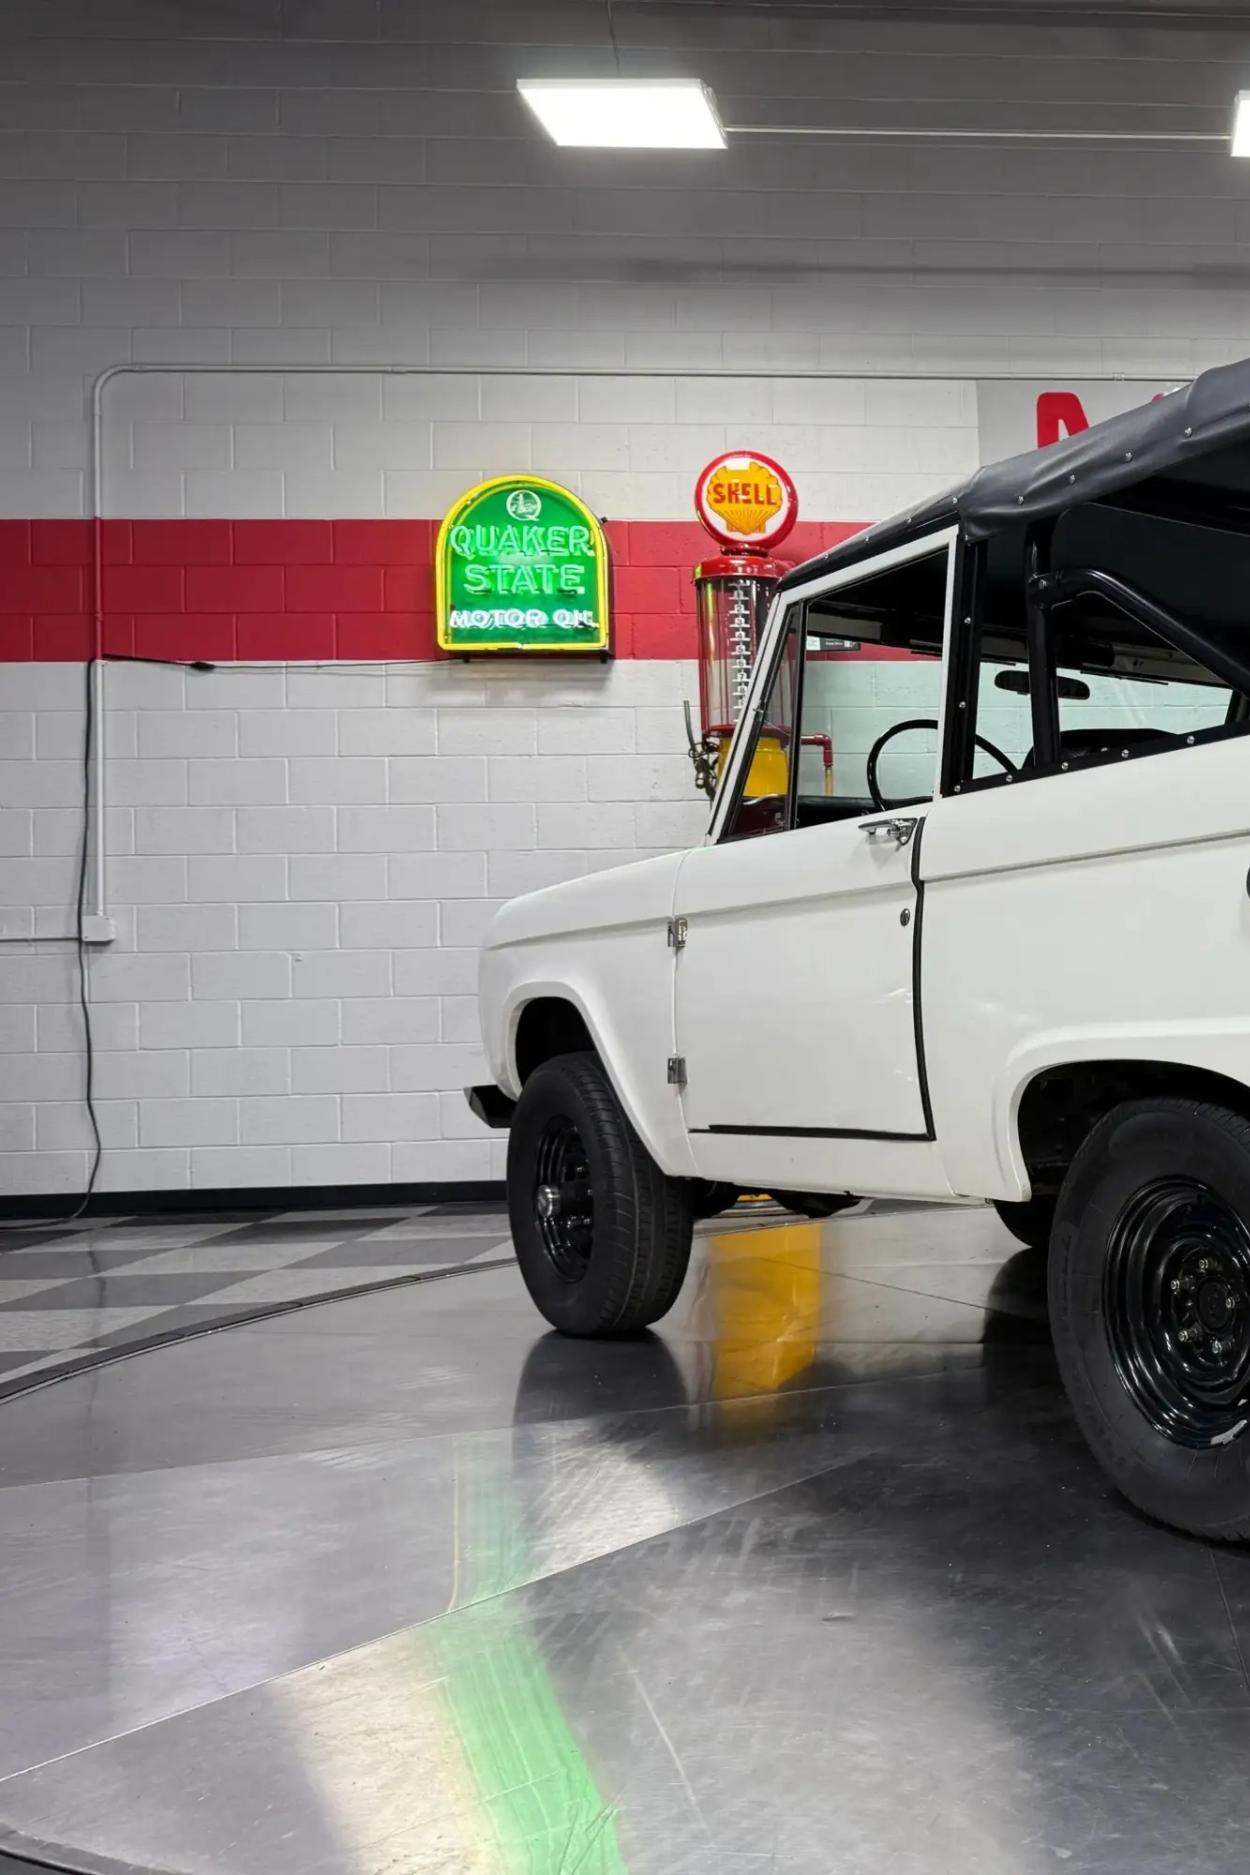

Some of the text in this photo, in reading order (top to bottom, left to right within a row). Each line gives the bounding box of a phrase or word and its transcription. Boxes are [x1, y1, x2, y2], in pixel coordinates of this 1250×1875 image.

[713, 483, 778, 506] SHELL
[450, 524, 596, 560] QUAKER
[464, 563, 586, 595] STATE
[449, 608, 600, 630] MOTOR OIL
